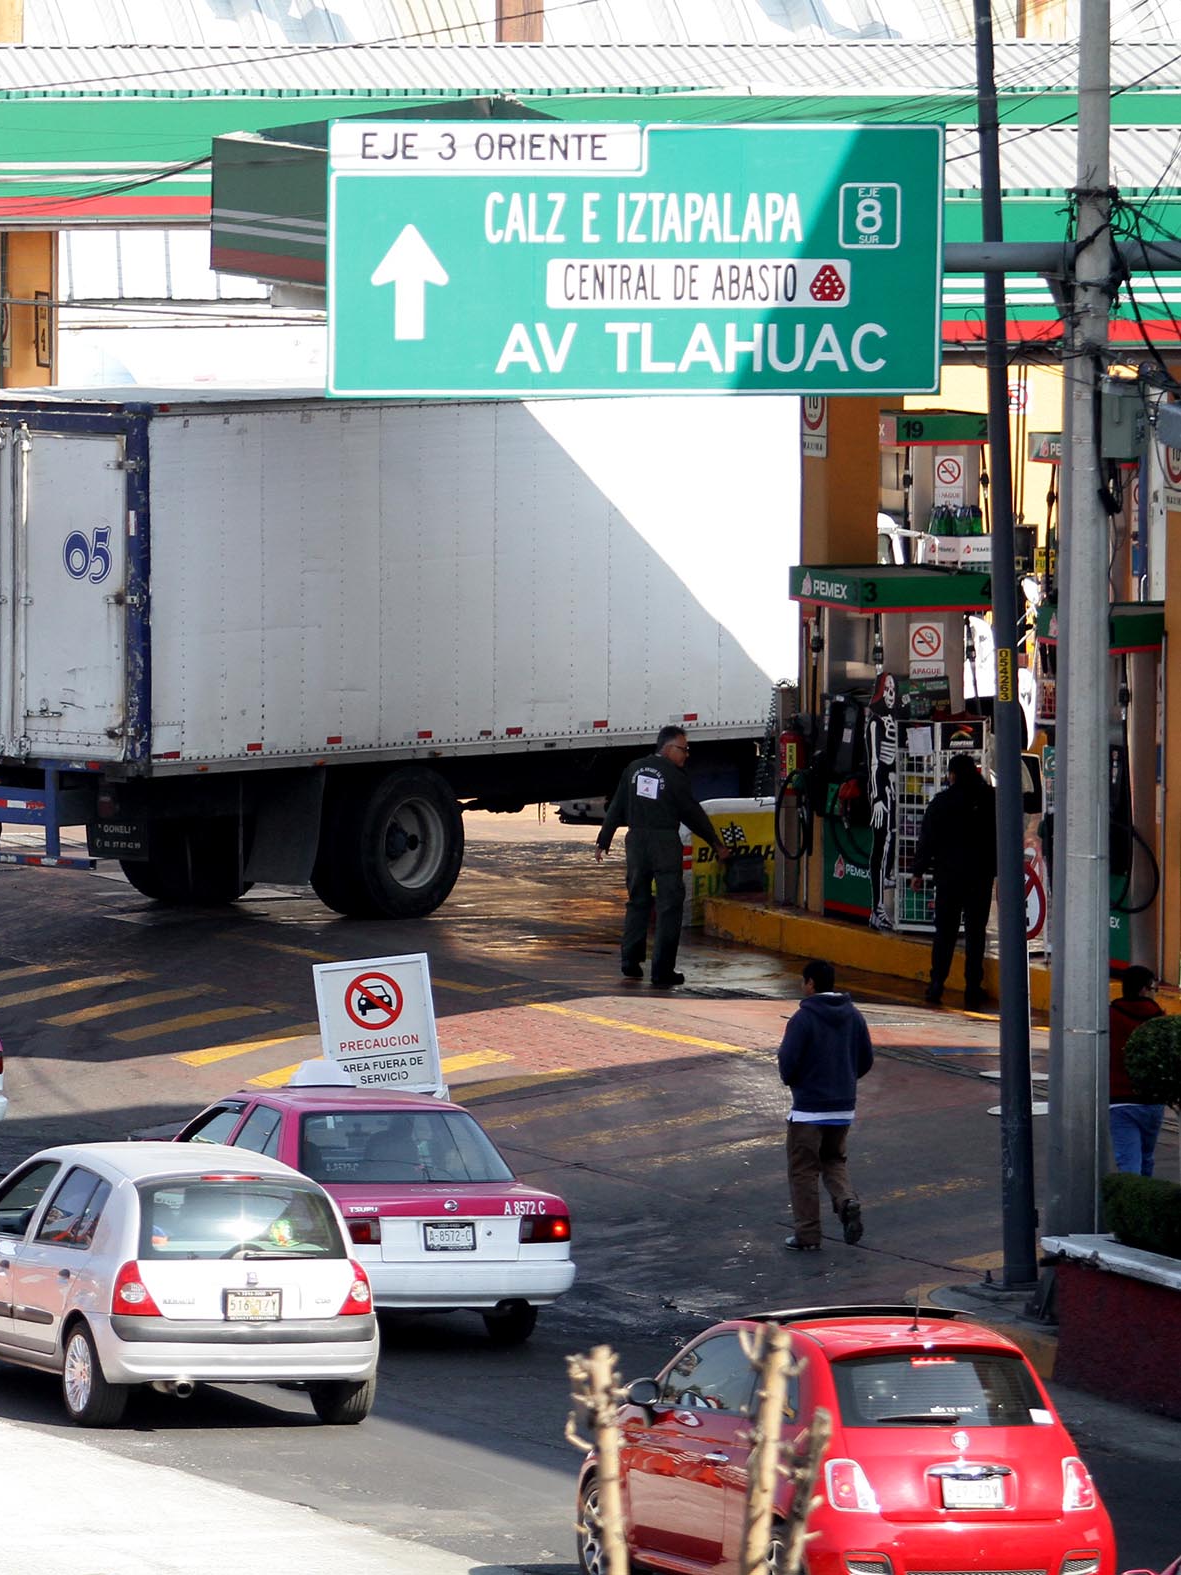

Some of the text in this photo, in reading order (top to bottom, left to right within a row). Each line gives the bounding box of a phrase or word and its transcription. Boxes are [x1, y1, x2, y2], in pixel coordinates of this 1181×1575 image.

[361, 132, 608, 162] EJE 3 ORIENTE
[858, 187, 881, 198] EJE
[483, 191, 803, 244] CALZ E IZTAPALAPA
[855, 198, 883, 235] 8
[858, 234, 880, 244] SUR
[563, 263, 798, 302] CENTRAL DE ABASTO
[494, 322, 889, 374] AV TLAHUAC
[902, 420, 924, 439] 19
[978, 418, 988, 437] 2
[62, 525, 113, 585] 05
[813, 580, 848, 600] PEMEX
[863, 582, 878, 603] 3
[912, 668, 941, 676] APAGUE
[998, 649, 1010, 701] 054263
[339, 1034, 420, 1053] PRECAUCION
[343, 1055, 424, 1073] AREA FUERA DE
[360, 1070, 409, 1085] SERVICIO
[348, 1206, 379, 1214] TSURU
[504, 1200, 547, 1215] A 8572 C
[428, 1230, 472, 1243] A-8572-C
